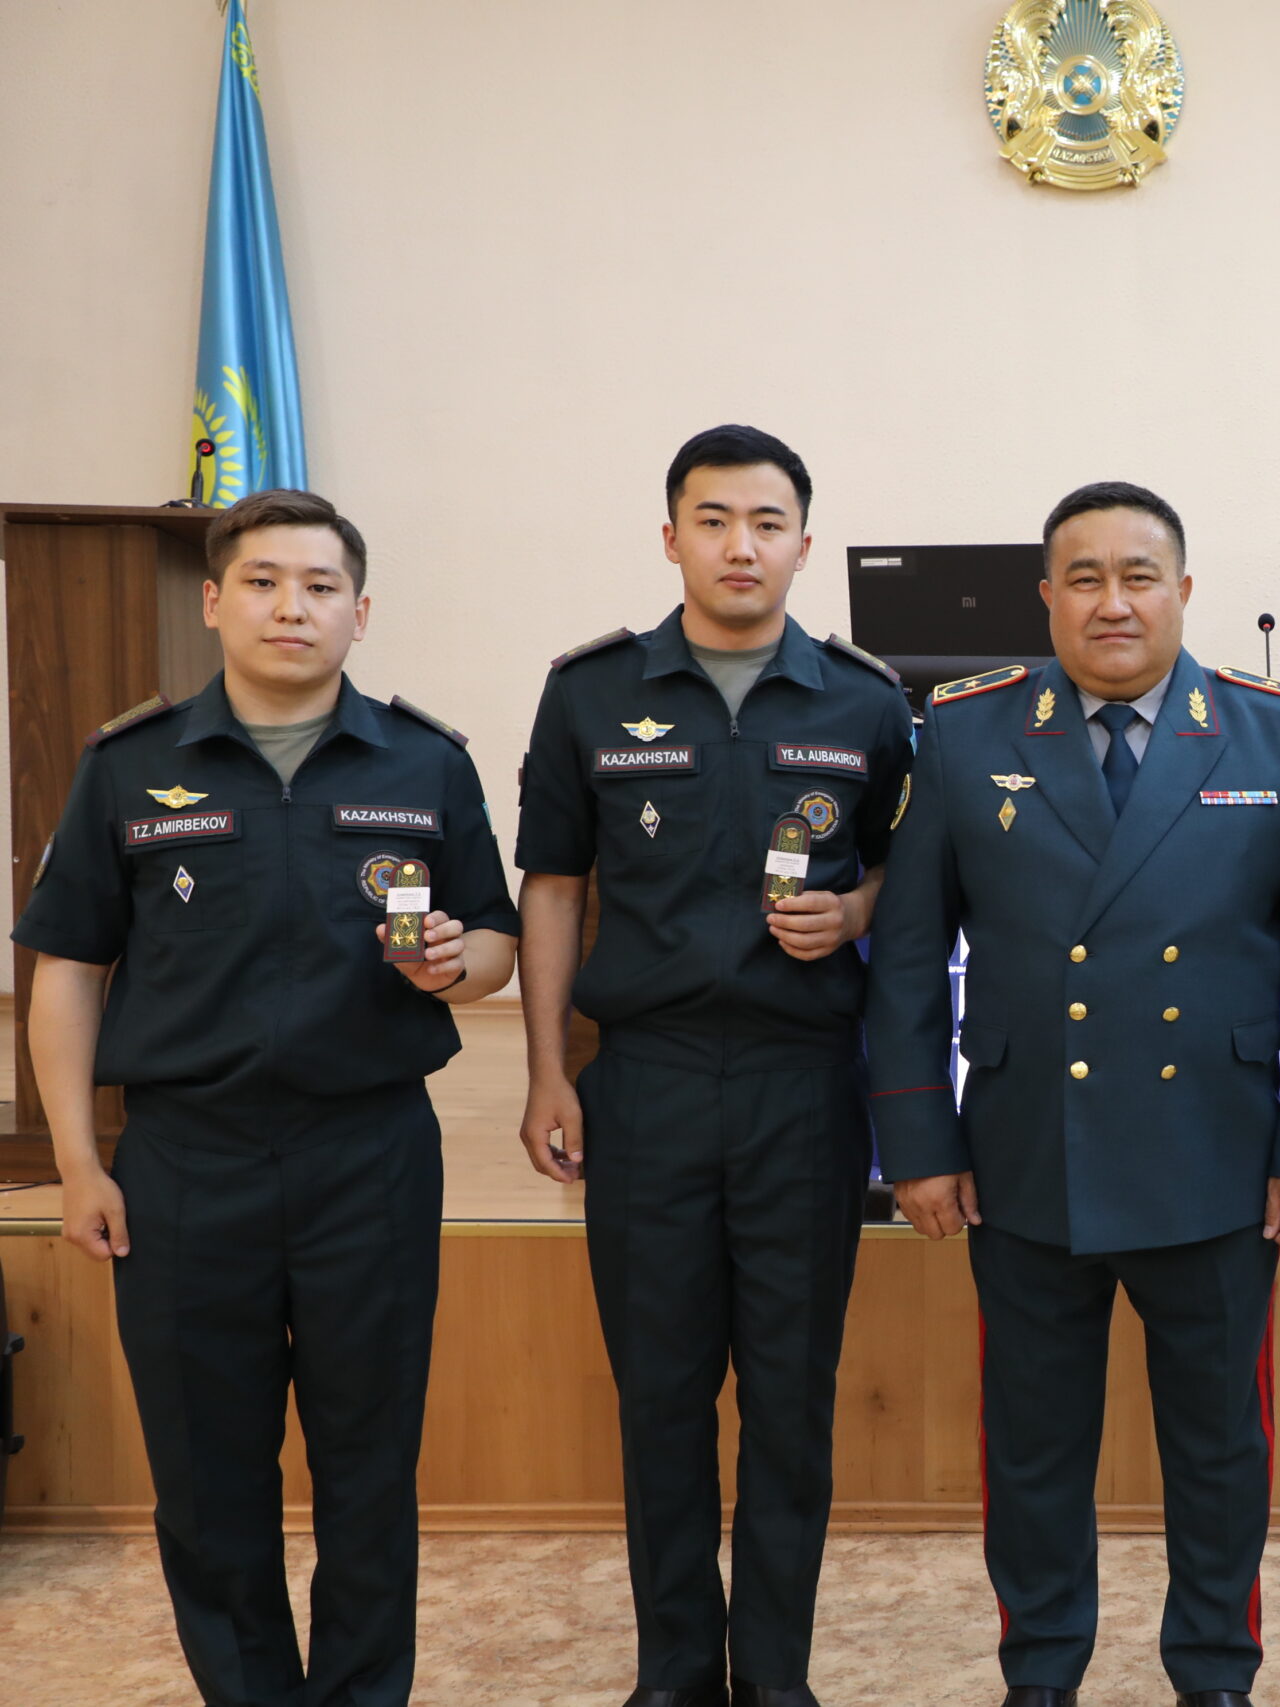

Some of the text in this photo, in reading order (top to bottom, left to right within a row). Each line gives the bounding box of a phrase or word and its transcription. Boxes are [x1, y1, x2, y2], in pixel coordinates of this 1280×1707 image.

[601, 751, 688, 766] KAZAKHSTAN
[781, 748, 861, 767] YE.A. AUBAKIROV
[340, 810, 433, 826] KAZAKHSTAN
[132, 816, 228, 839] T.Z. AMIRBEKOV
